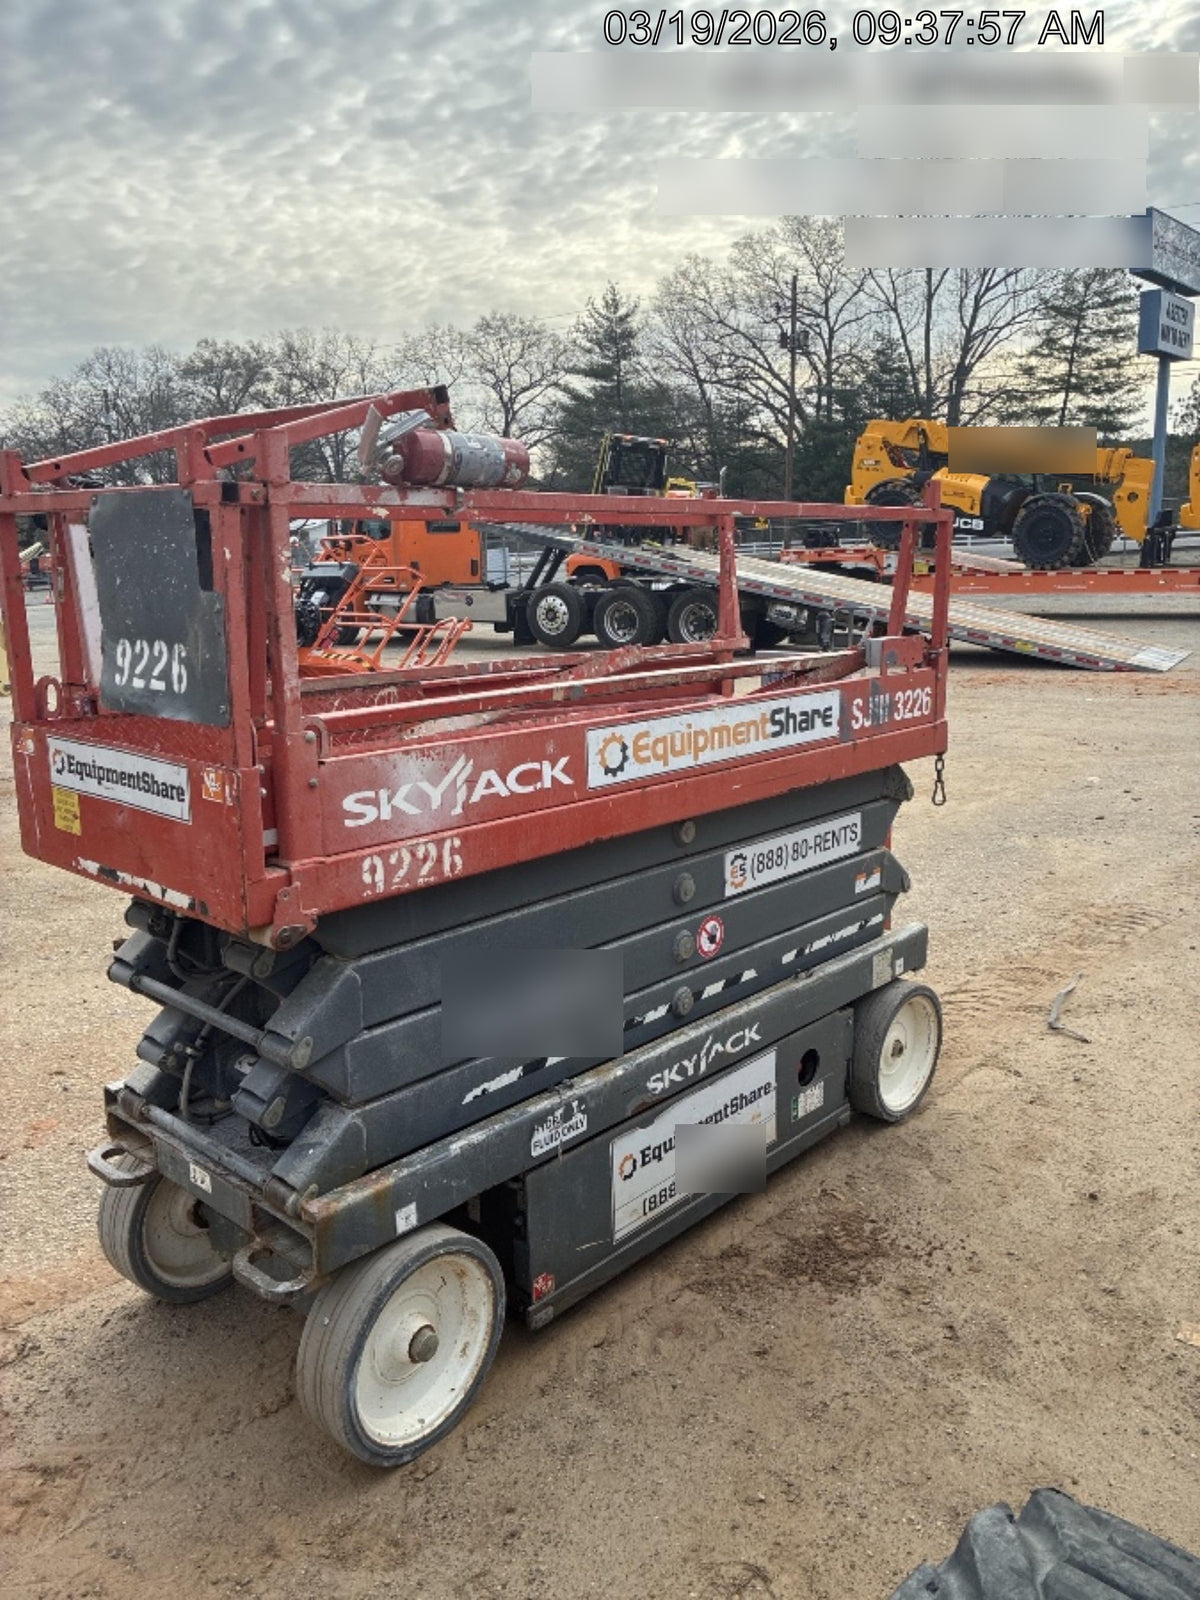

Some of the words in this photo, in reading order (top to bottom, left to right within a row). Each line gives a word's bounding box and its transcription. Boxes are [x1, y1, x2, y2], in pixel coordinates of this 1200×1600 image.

[953, 516, 984, 531] JCB
[115, 638, 188, 694] 9226
[894, 686, 932, 720] 3226
[632, 705, 833, 766] EquipmentShare
[67, 754, 187, 803] EquipmentShare
[342, 754, 574, 828] SKYJACK
[361, 837, 463, 896] 9226
[751, 843, 789, 880] (888)
[791, 822, 858, 861] 80-RENTS
[646, 1022, 762, 1094] SKYJACK
[643, 1181, 677, 1216] (888
